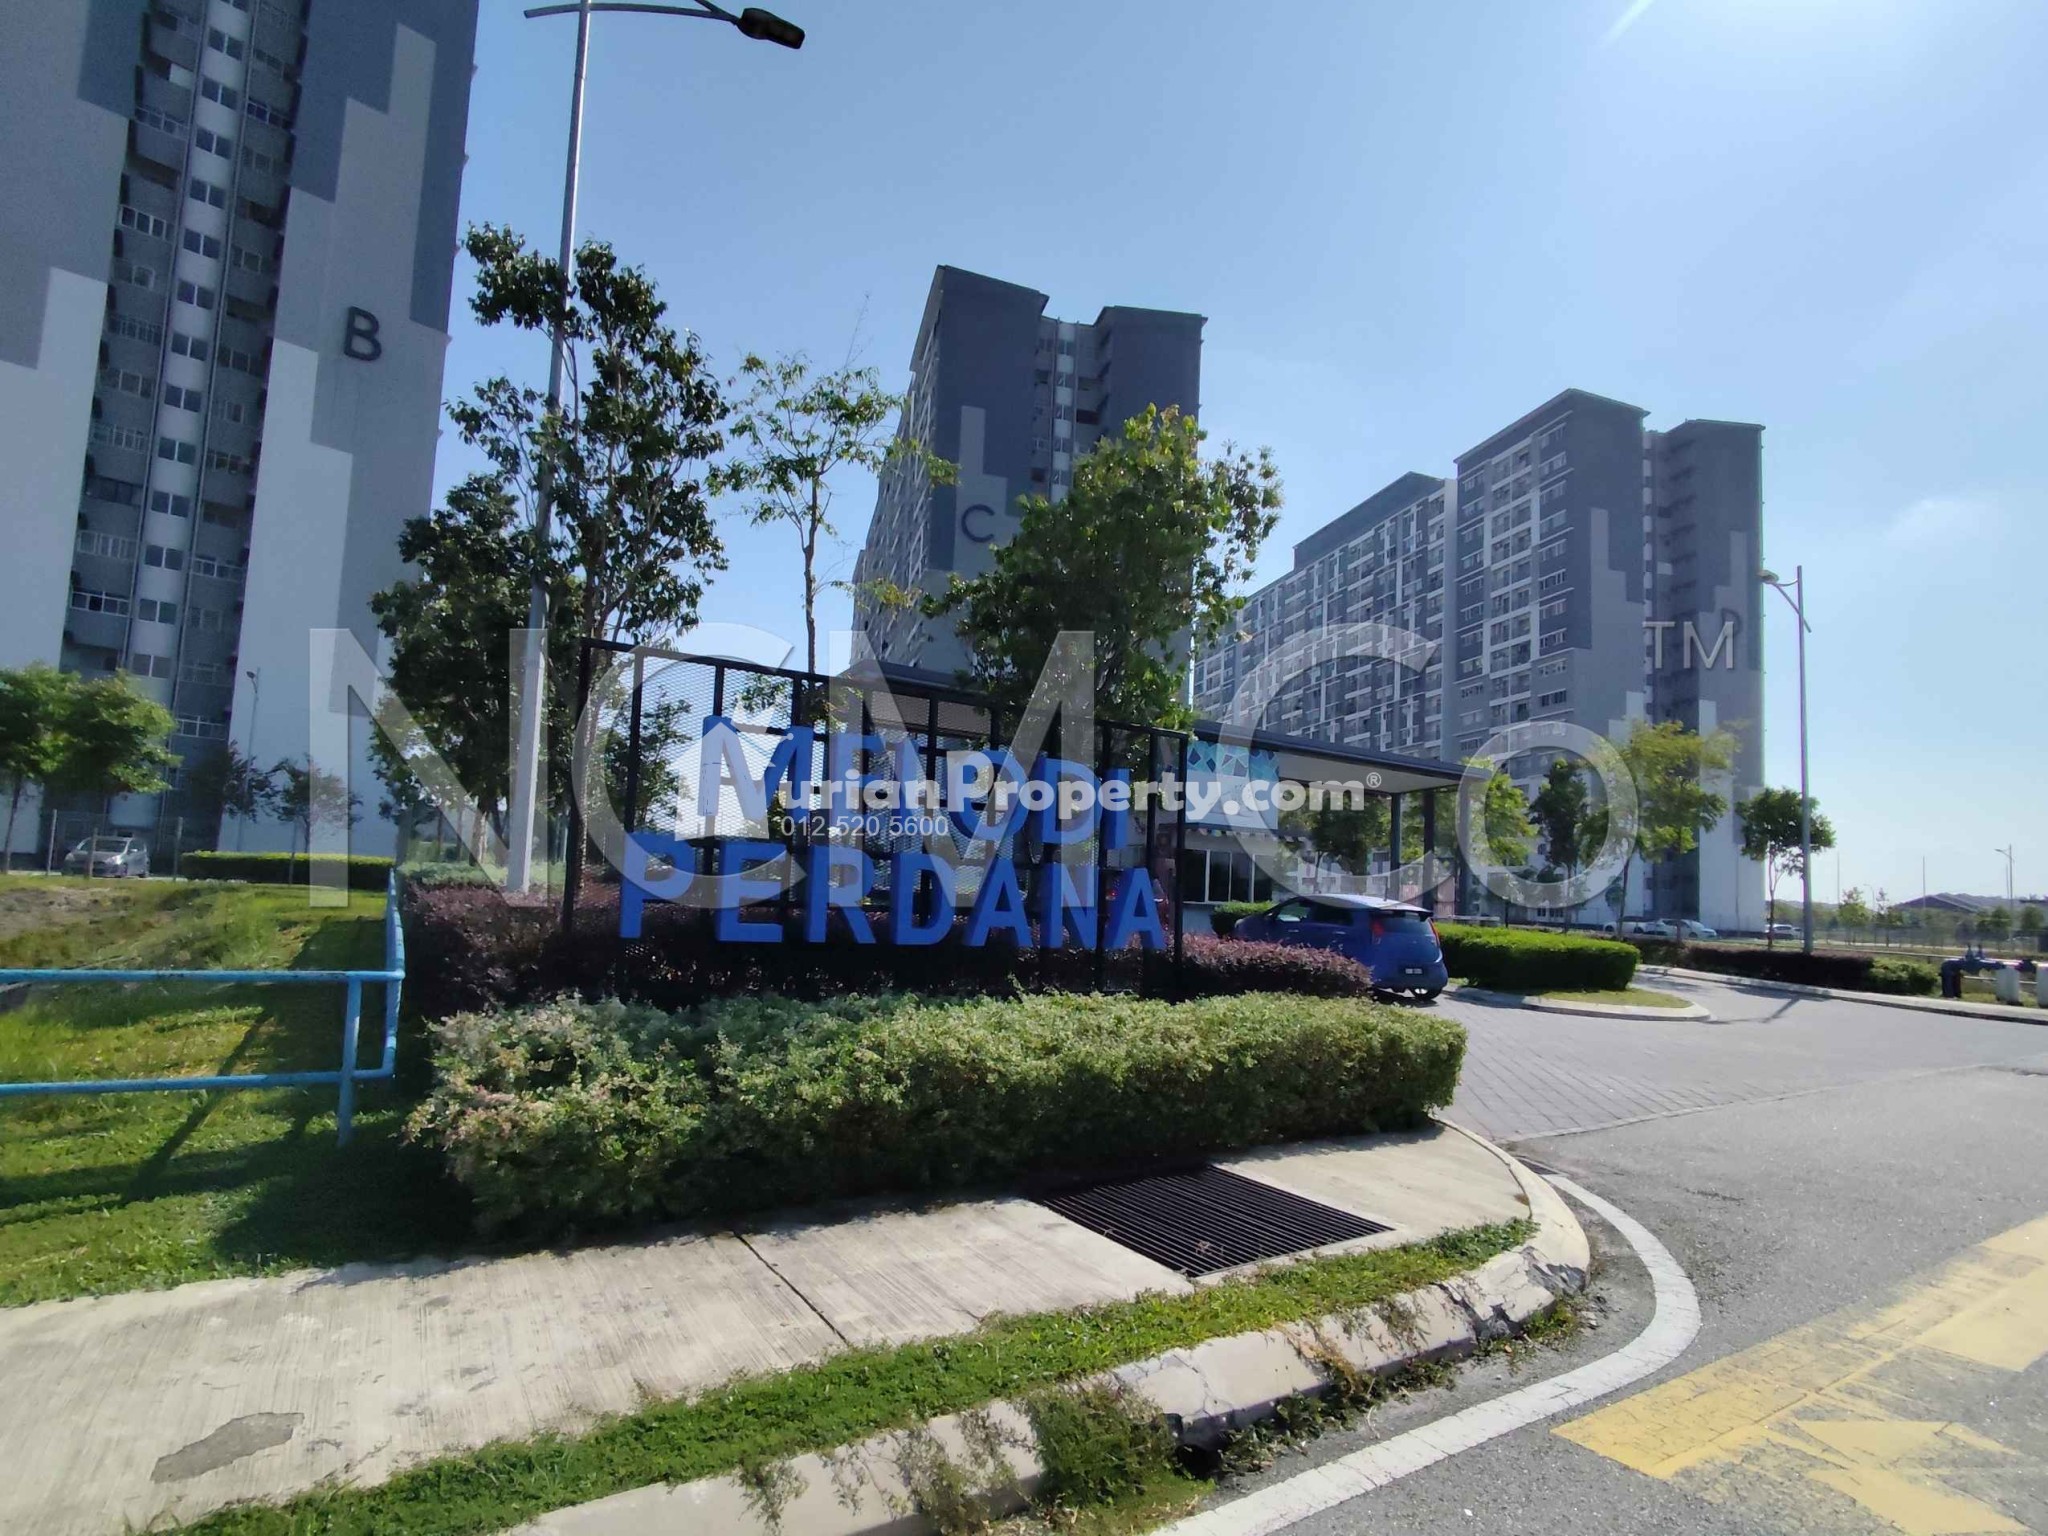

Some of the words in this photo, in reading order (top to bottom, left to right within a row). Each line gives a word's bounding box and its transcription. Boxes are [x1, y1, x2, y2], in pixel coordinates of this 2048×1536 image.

[344, 306, 382, 361] B
[961, 504, 995, 542] C
[619, 831, 1167, 948] PERDANA
